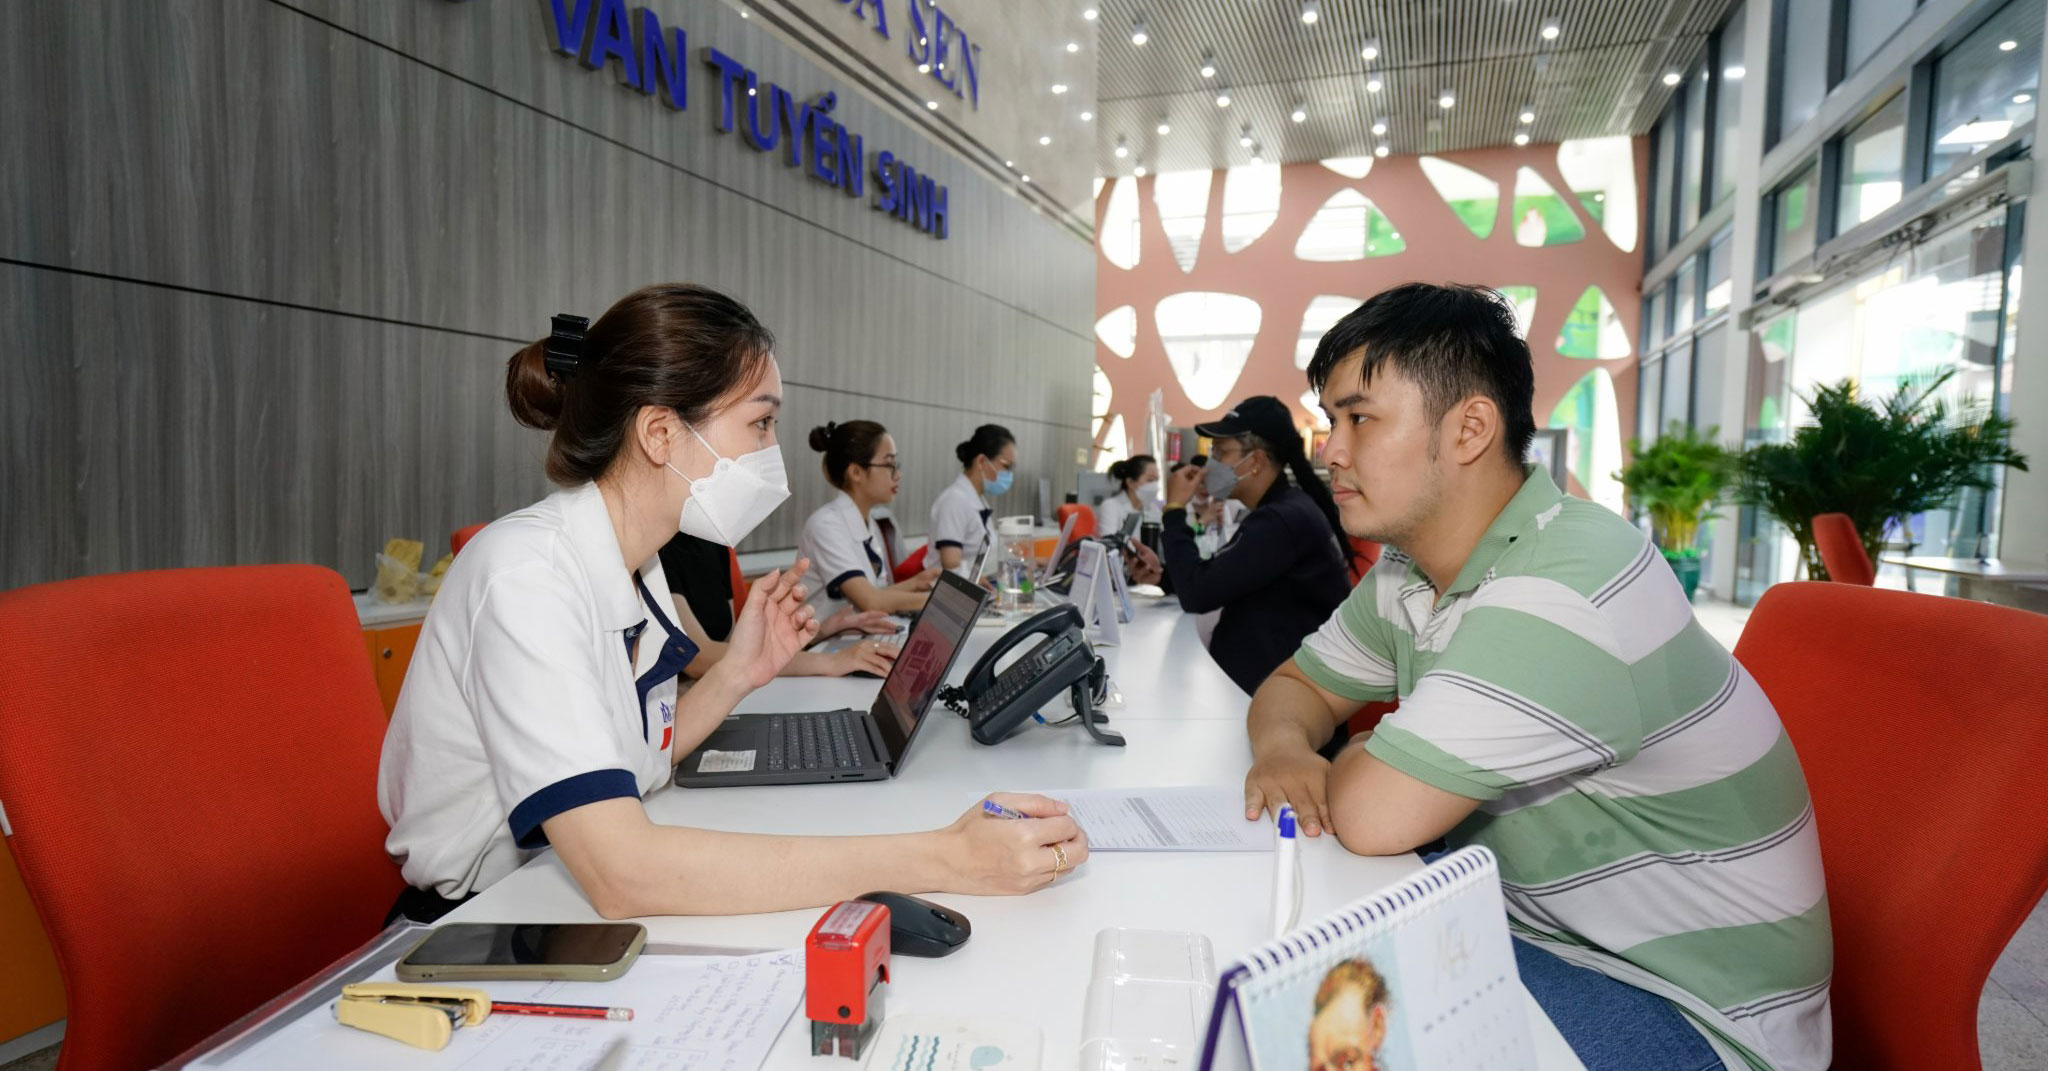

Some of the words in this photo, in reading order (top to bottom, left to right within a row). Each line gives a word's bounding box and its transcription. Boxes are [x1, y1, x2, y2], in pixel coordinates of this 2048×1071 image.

[907, 0, 981, 111] SEN
[702, 46, 863, 198] TUYỂN
[874, 150, 948, 240] SINH
